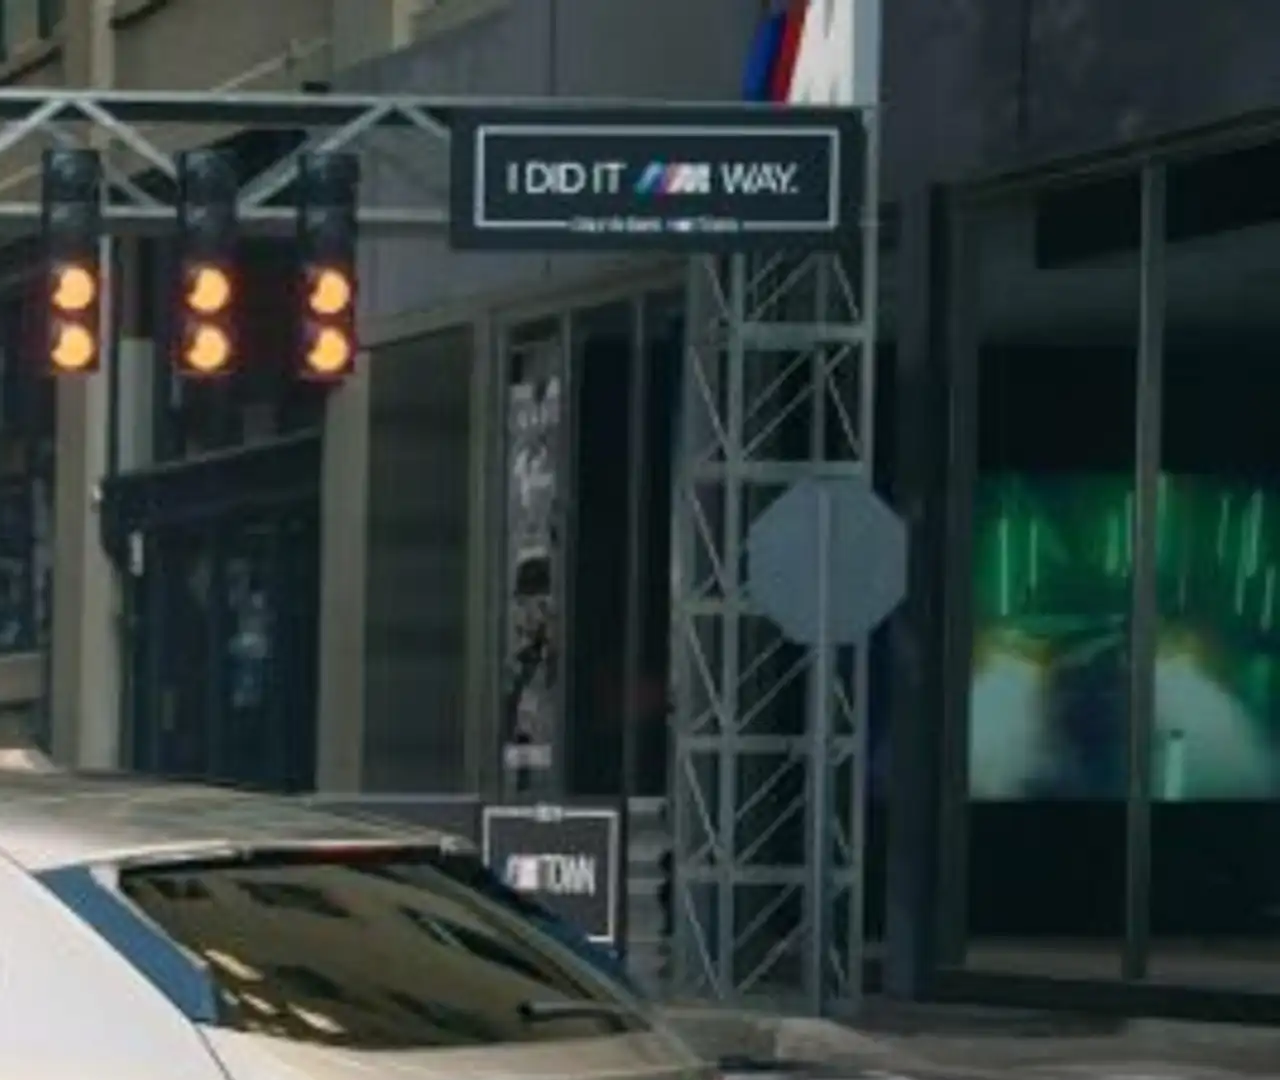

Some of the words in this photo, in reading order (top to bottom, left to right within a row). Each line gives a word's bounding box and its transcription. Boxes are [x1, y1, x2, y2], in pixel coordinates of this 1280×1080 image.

[507, 163, 518, 194] I
[525, 163, 588, 194] DID
[593, 163, 627, 194] IT
[720, 163, 799, 195] WAY.
